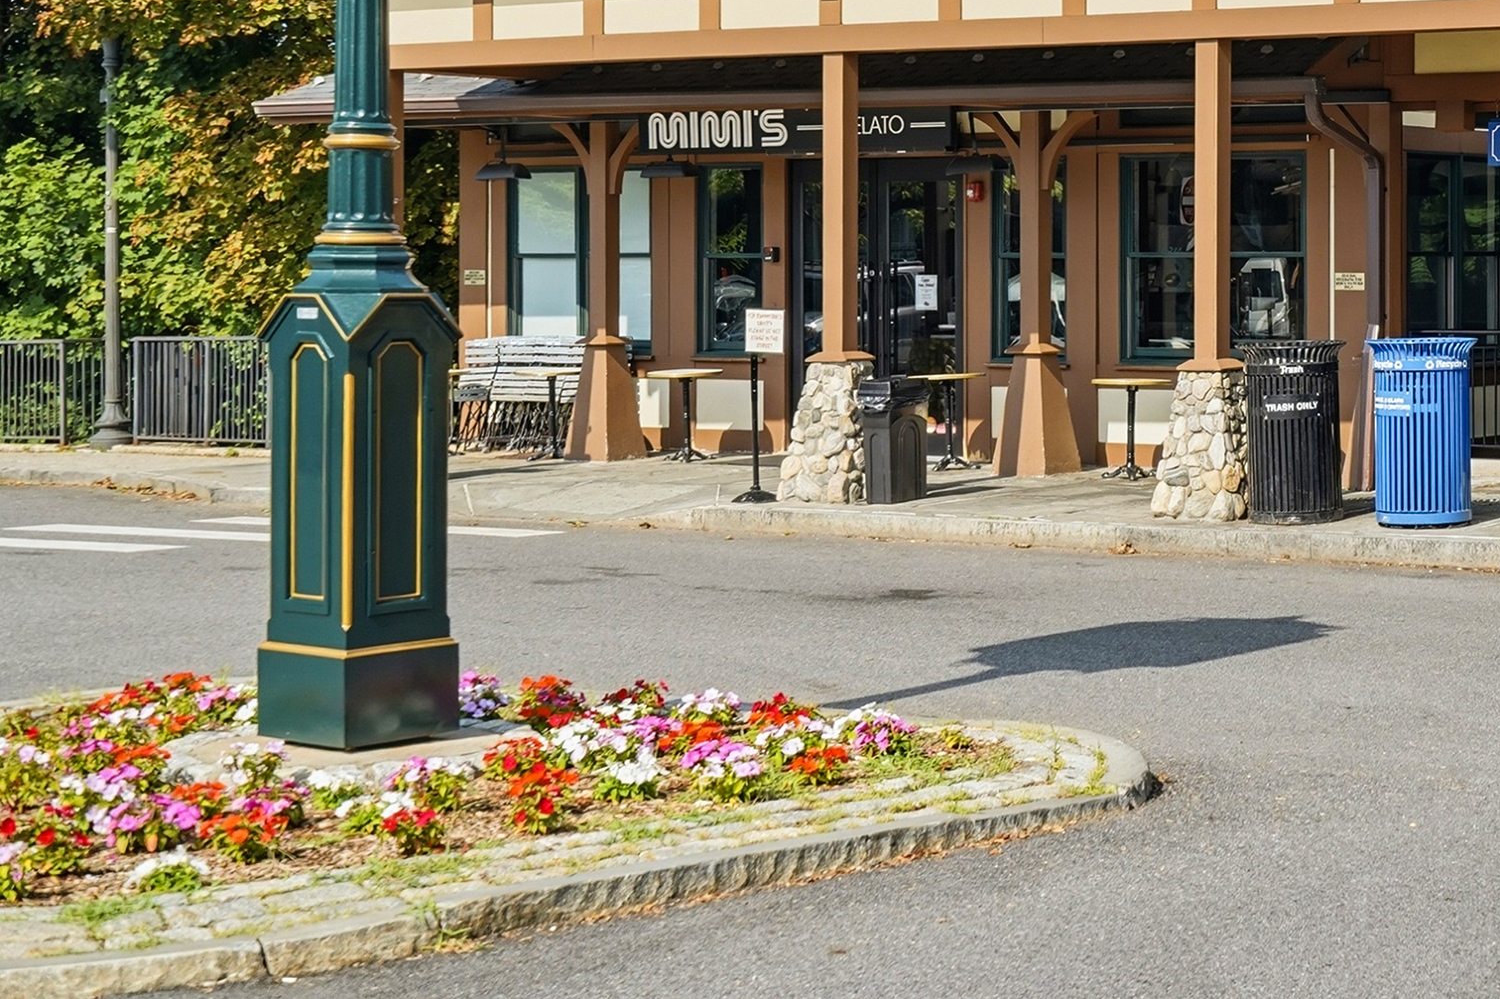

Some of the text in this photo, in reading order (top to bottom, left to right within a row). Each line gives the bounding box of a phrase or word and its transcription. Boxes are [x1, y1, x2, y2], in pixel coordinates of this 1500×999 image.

[648, 108, 905, 150] MIMI'S LATO
[1279, 365, 1304, 375] Trash
[1265, 400, 1319, 413] TRASH ONLY
